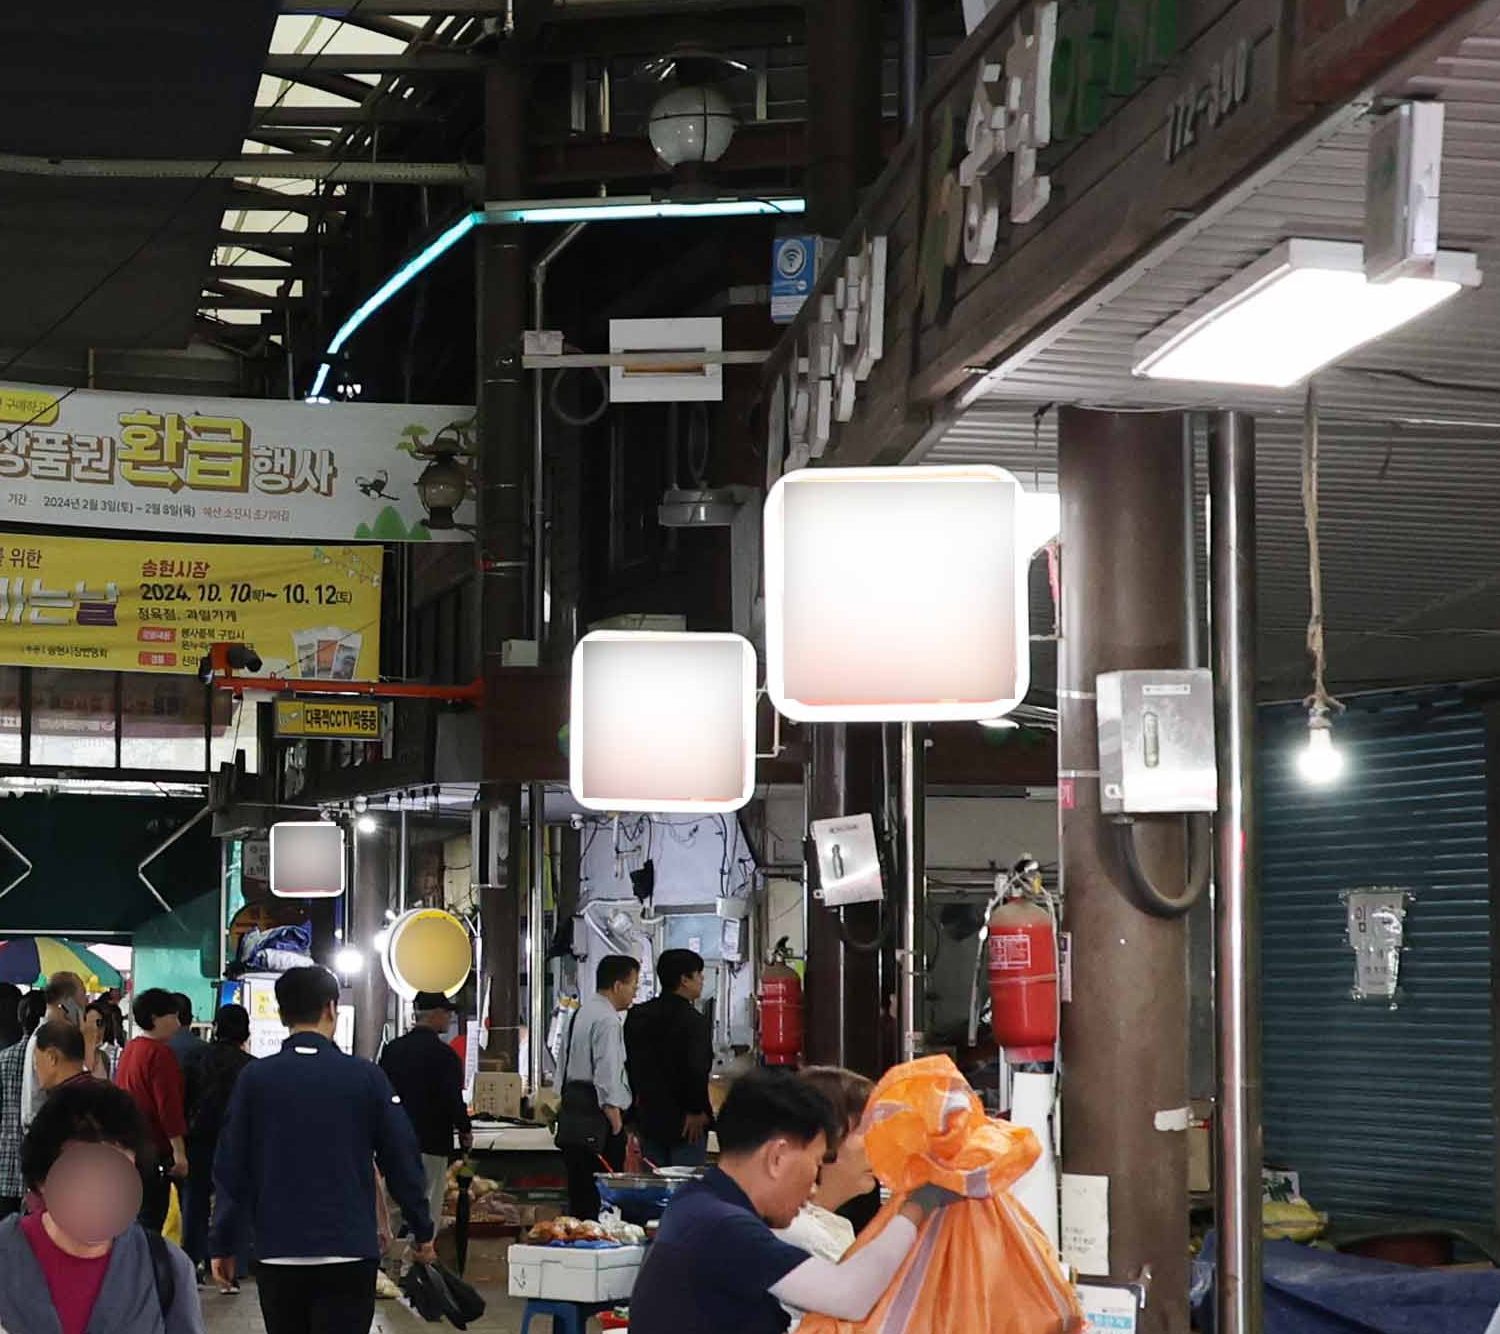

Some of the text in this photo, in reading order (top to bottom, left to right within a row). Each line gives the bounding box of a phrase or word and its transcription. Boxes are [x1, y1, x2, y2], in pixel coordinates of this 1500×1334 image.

[117, 409, 250, 494] 환급
[252, 446, 338, 498] 행사
[9, 547, 43, 569] 위한
[142, 559, 211, 579] 송현시장
[140, 583, 192, 602] 2024.
[198, 583, 223, 603] 10.
[284, 584, 311, 605] 10.
